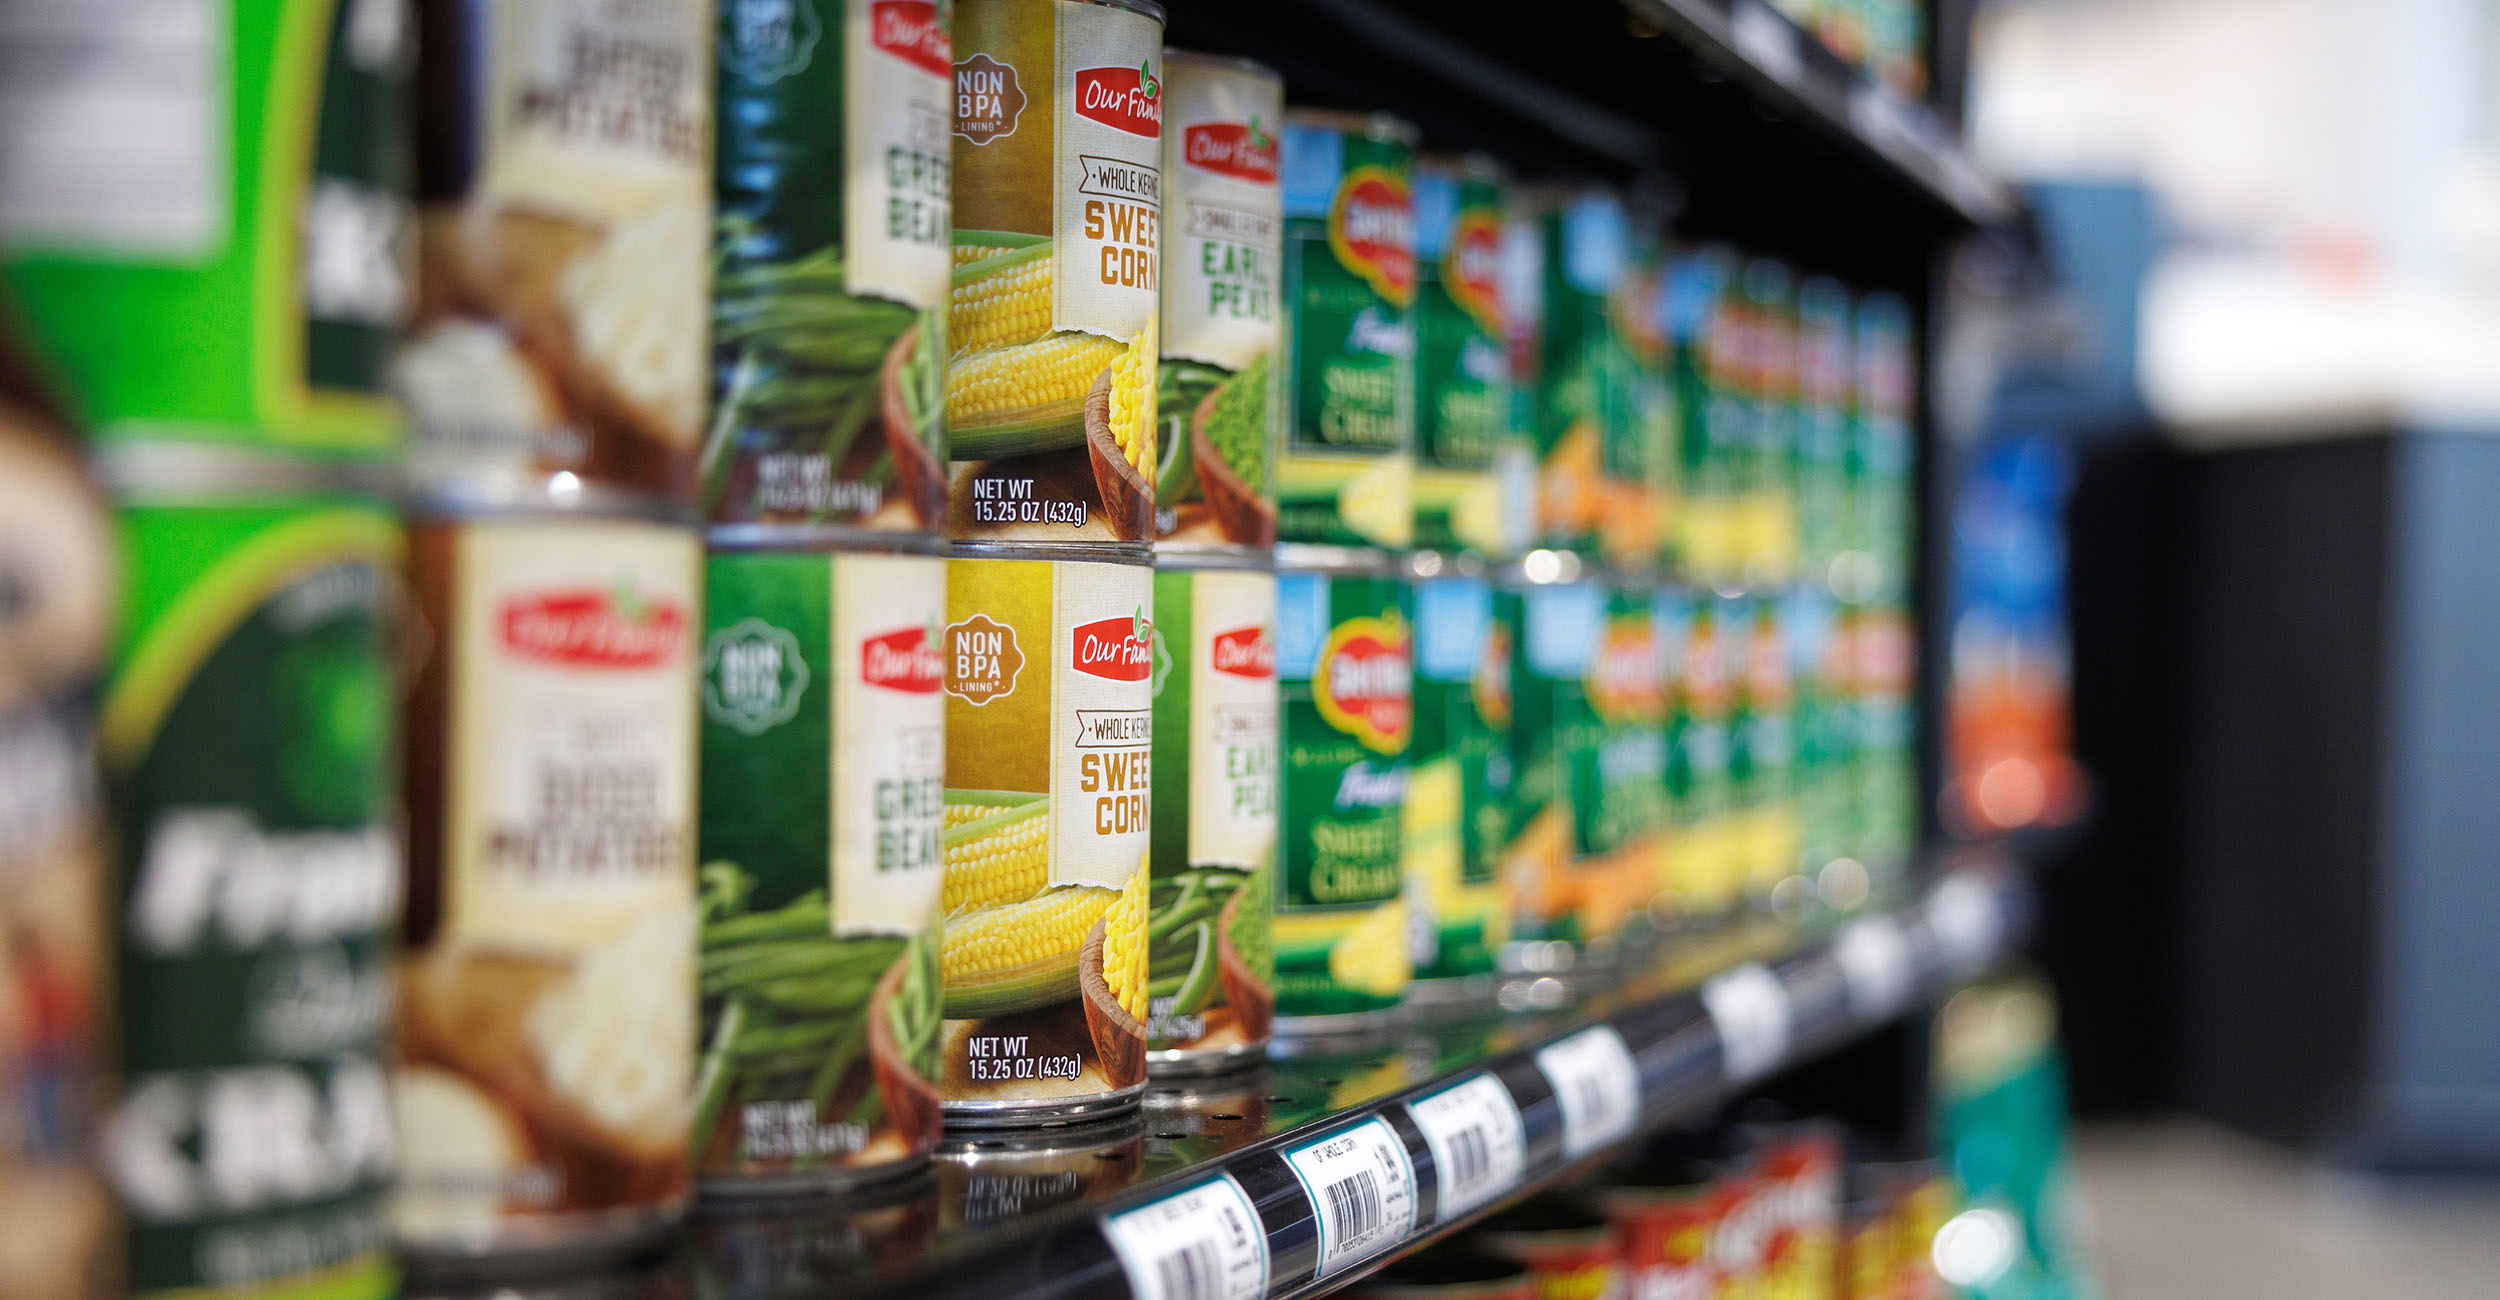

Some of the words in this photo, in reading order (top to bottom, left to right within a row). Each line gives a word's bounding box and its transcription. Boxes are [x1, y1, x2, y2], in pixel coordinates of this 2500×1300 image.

[958, 71, 1003, 95] NON
[1085, 80, 1126, 111] Our
[958, 95, 1003, 118] BPA
[1098, 165, 1136, 193] WHOLE
[1085, 200, 1160, 249] SWEE
[1101, 246, 1157, 293] CORN
[974, 479, 1004, 499] NET
[1008, 479, 1034, 499] WT
[974, 501, 1016, 521] 15.25
[1021, 502, 1040, 521] OZ
[1044, 500, 1087, 527] (432g)
[957, 632, 1002, 655] NON
[1082, 634, 1121, 664] Our
[1122, 635, 1151, 665] Fam
[957, 655, 1001, 679] BPA
[1094, 718, 1129, 740] WHOLE
[1080, 752, 1151, 792] SWEE
[1096, 794, 1150, 835] CORN
[969, 1037, 1000, 1057] NET
[1003, 1036, 1029, 1056] WT
[969, 1059, 1011, 1080] 15.25
[1016, 1058, 1035, 1078] OZ
[1038, 1053, 1081, 1080] (432g)
